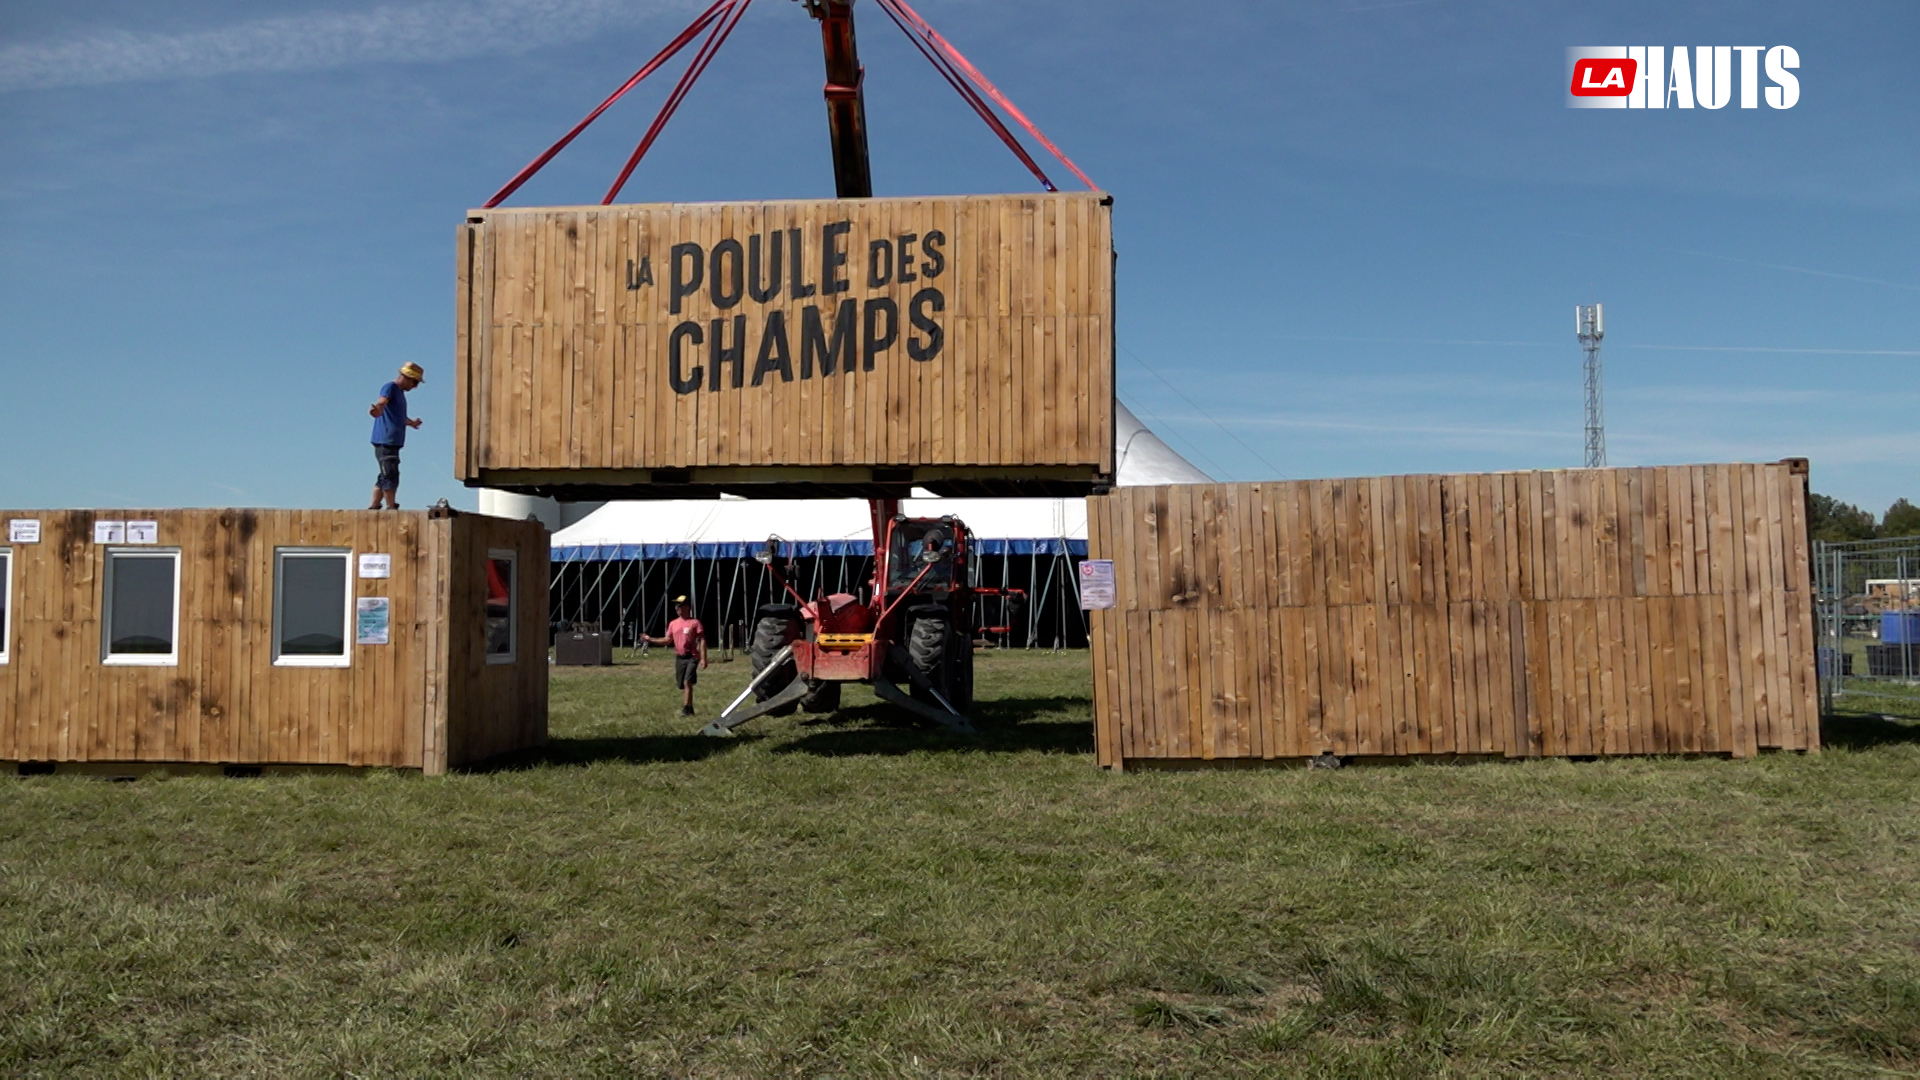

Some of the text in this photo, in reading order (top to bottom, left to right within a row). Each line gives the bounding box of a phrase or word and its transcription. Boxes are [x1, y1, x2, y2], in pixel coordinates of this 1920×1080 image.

[627, 221, 946, 315] LA POULE DES
[669, 288, 946, 394] CHAMPS
